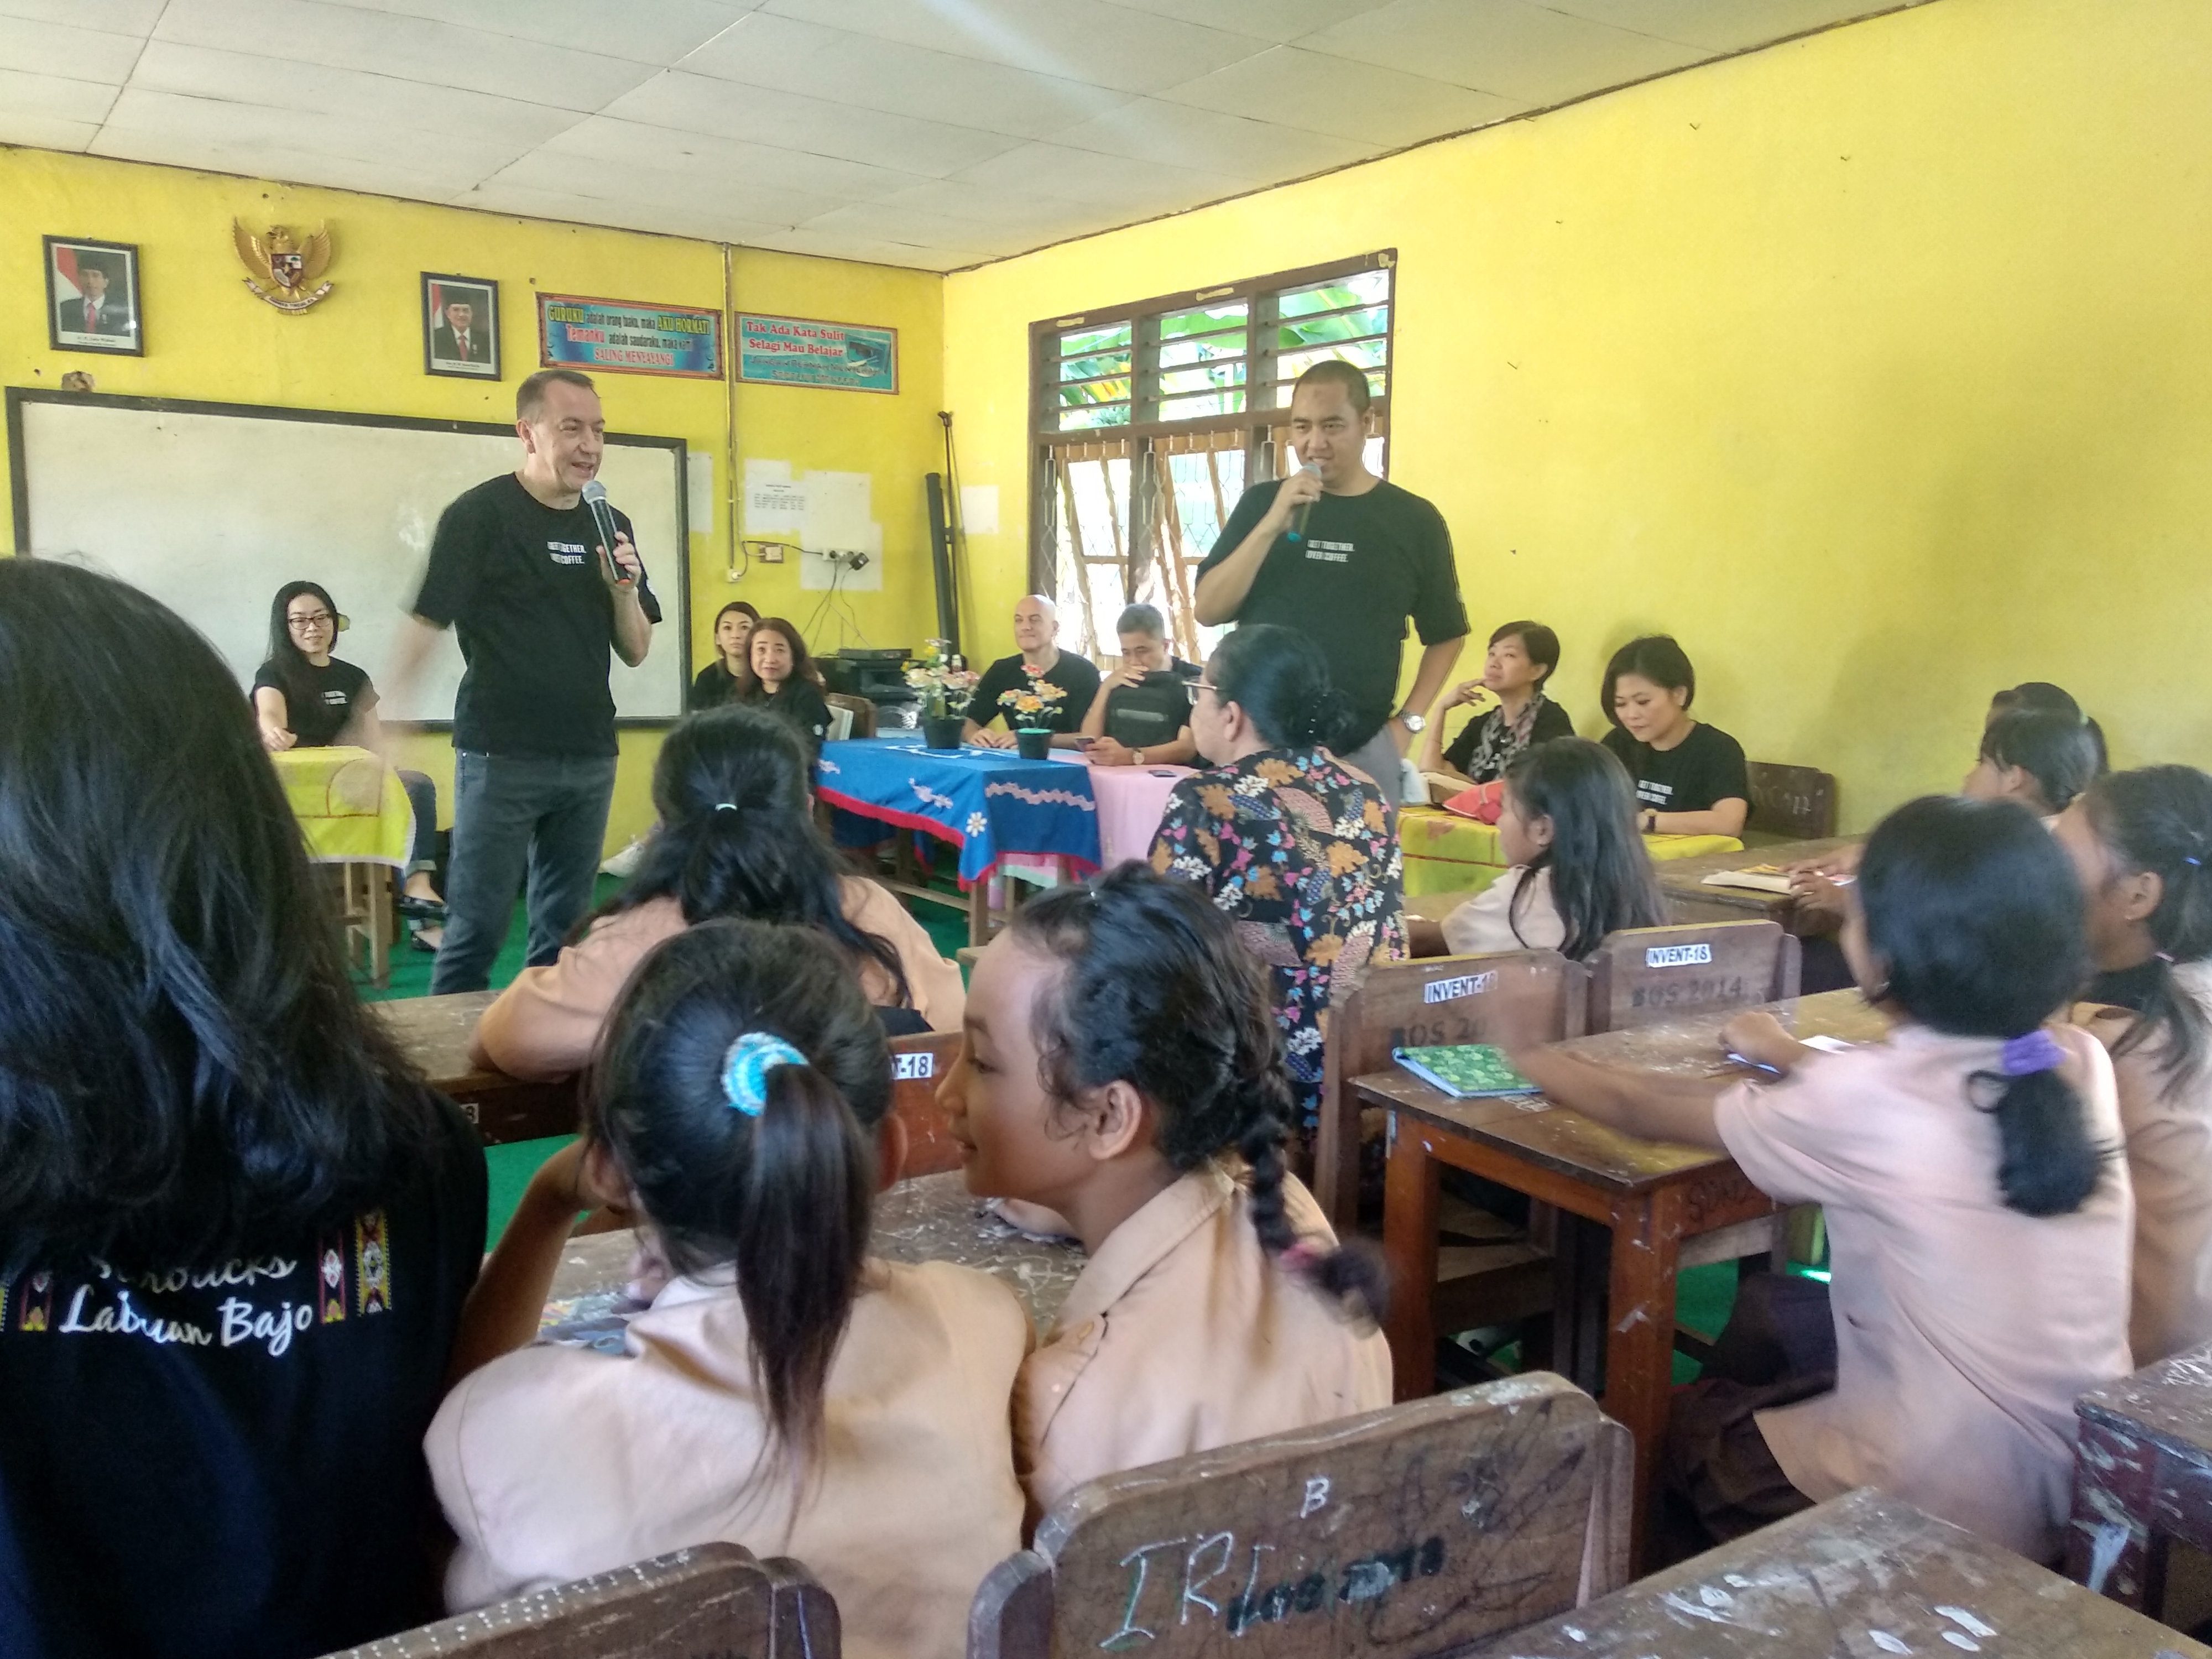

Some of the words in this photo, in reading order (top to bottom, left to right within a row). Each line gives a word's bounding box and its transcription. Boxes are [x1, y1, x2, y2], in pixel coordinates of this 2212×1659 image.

[747, 321, 766, 332] Tak
[770, 324, 790, 335] Ada
[793, 326, 817, 338] Kata
[820, 328, 844, 341] Sulit
[749, 338, 780, 353] Selagi
[783, 343, 804, 353] Mau
[807, 344, 843, 358] Belajar
[1648, 946, 1708, 964] INVENT-18
[216, 1296, 314, 1358] Bajo
[1300, 1476, 1330, 1519] B
